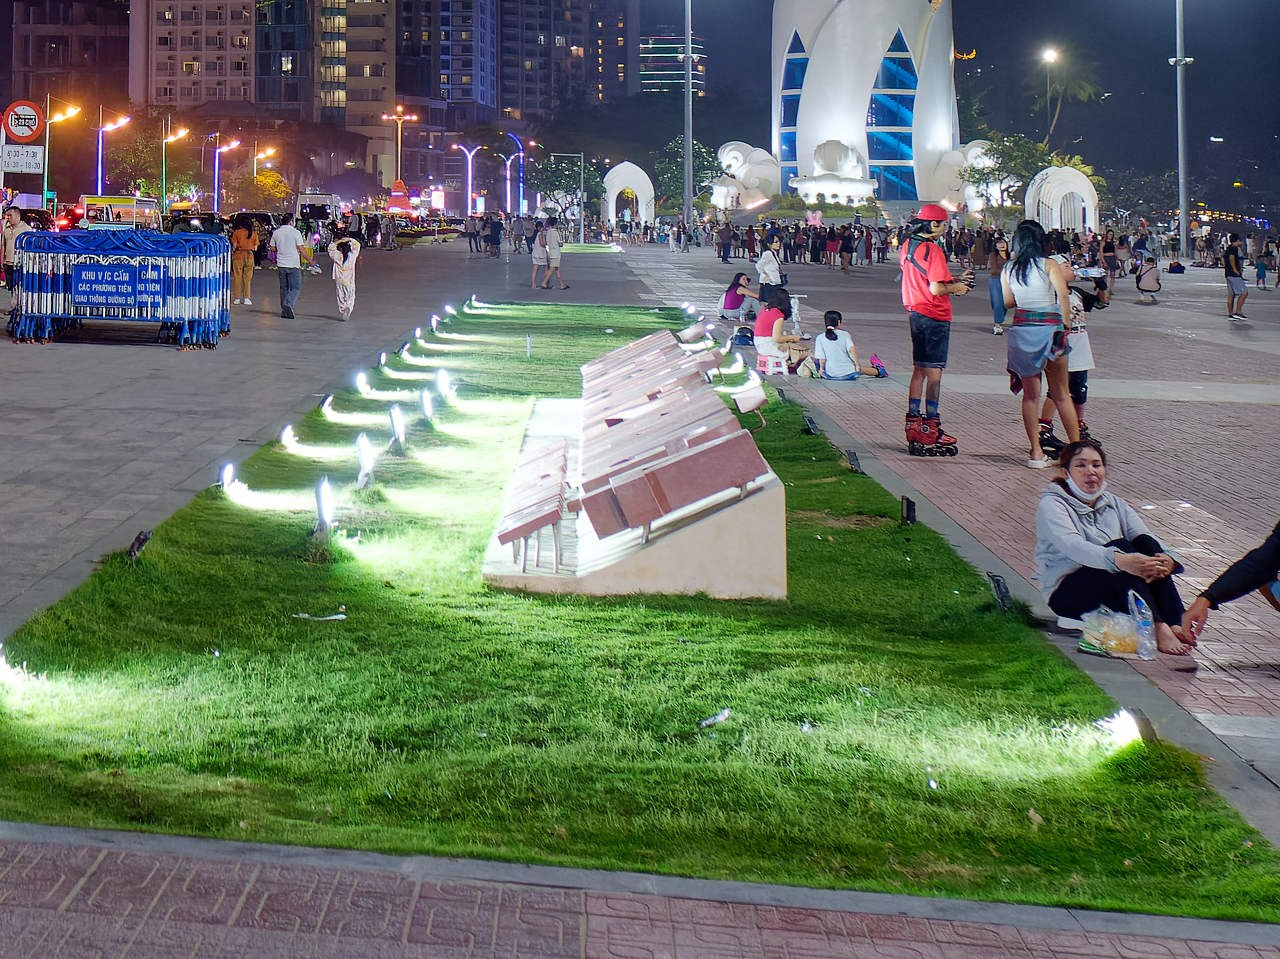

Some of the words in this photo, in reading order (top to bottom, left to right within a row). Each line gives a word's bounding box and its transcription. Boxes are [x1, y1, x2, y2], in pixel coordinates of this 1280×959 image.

[81, 271, 96, 281] KHU
[113, 269, 130, 281] CẤM
[78, 282, 91, 291] CÁC
[74, 295, 88, 303] GIAO
[89, 294, 107, 303] THÔNG
